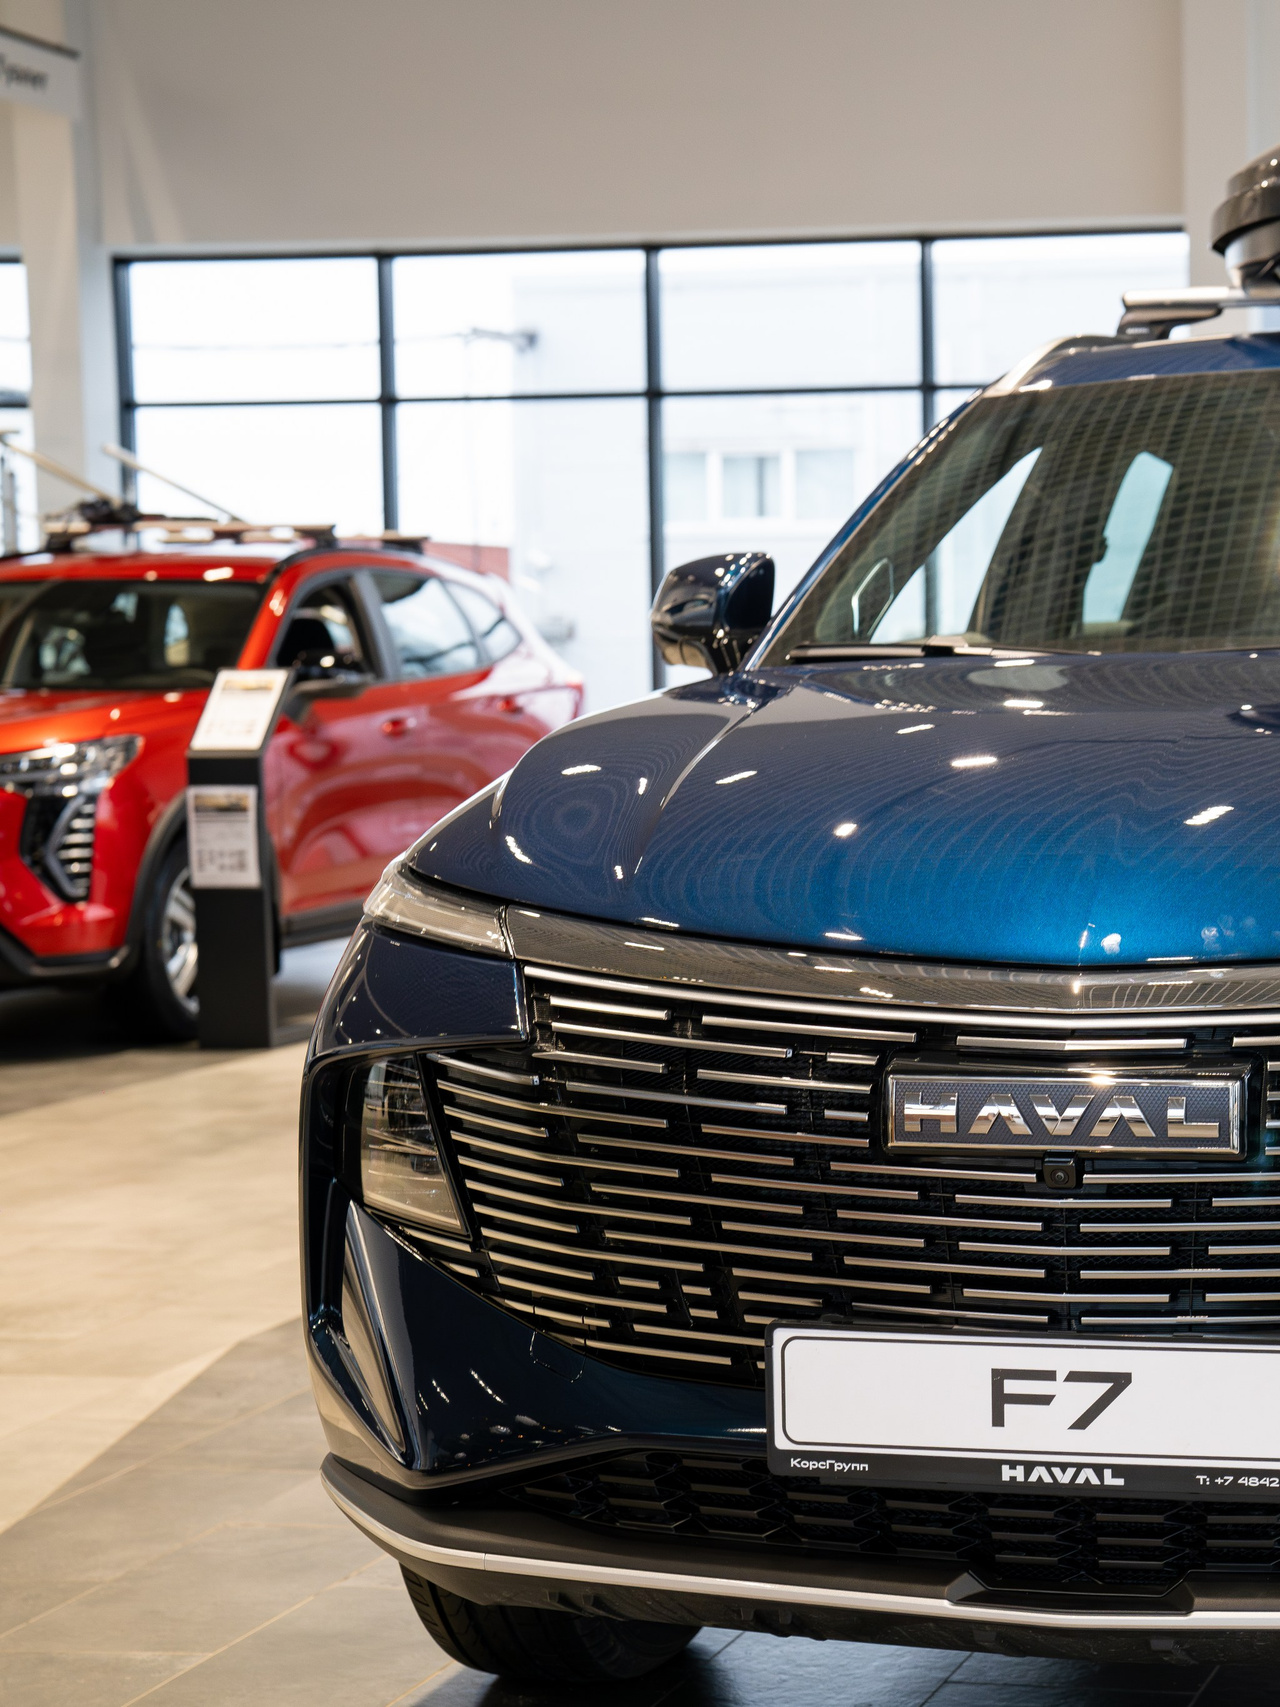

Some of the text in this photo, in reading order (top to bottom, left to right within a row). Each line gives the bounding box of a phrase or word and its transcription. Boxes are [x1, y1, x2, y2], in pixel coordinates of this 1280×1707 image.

[903, 1091, 1220, 1139] HAVAL
[991, 1368, 1133, 1431] F7
[790, 1458, 869, 1472] КорсГрупп
[1001, 1464, 1125, 1487] HAVAL
[1214, 1476, 1234, 1486] +7
[1238, 1476, 1280, 1487] 4842
